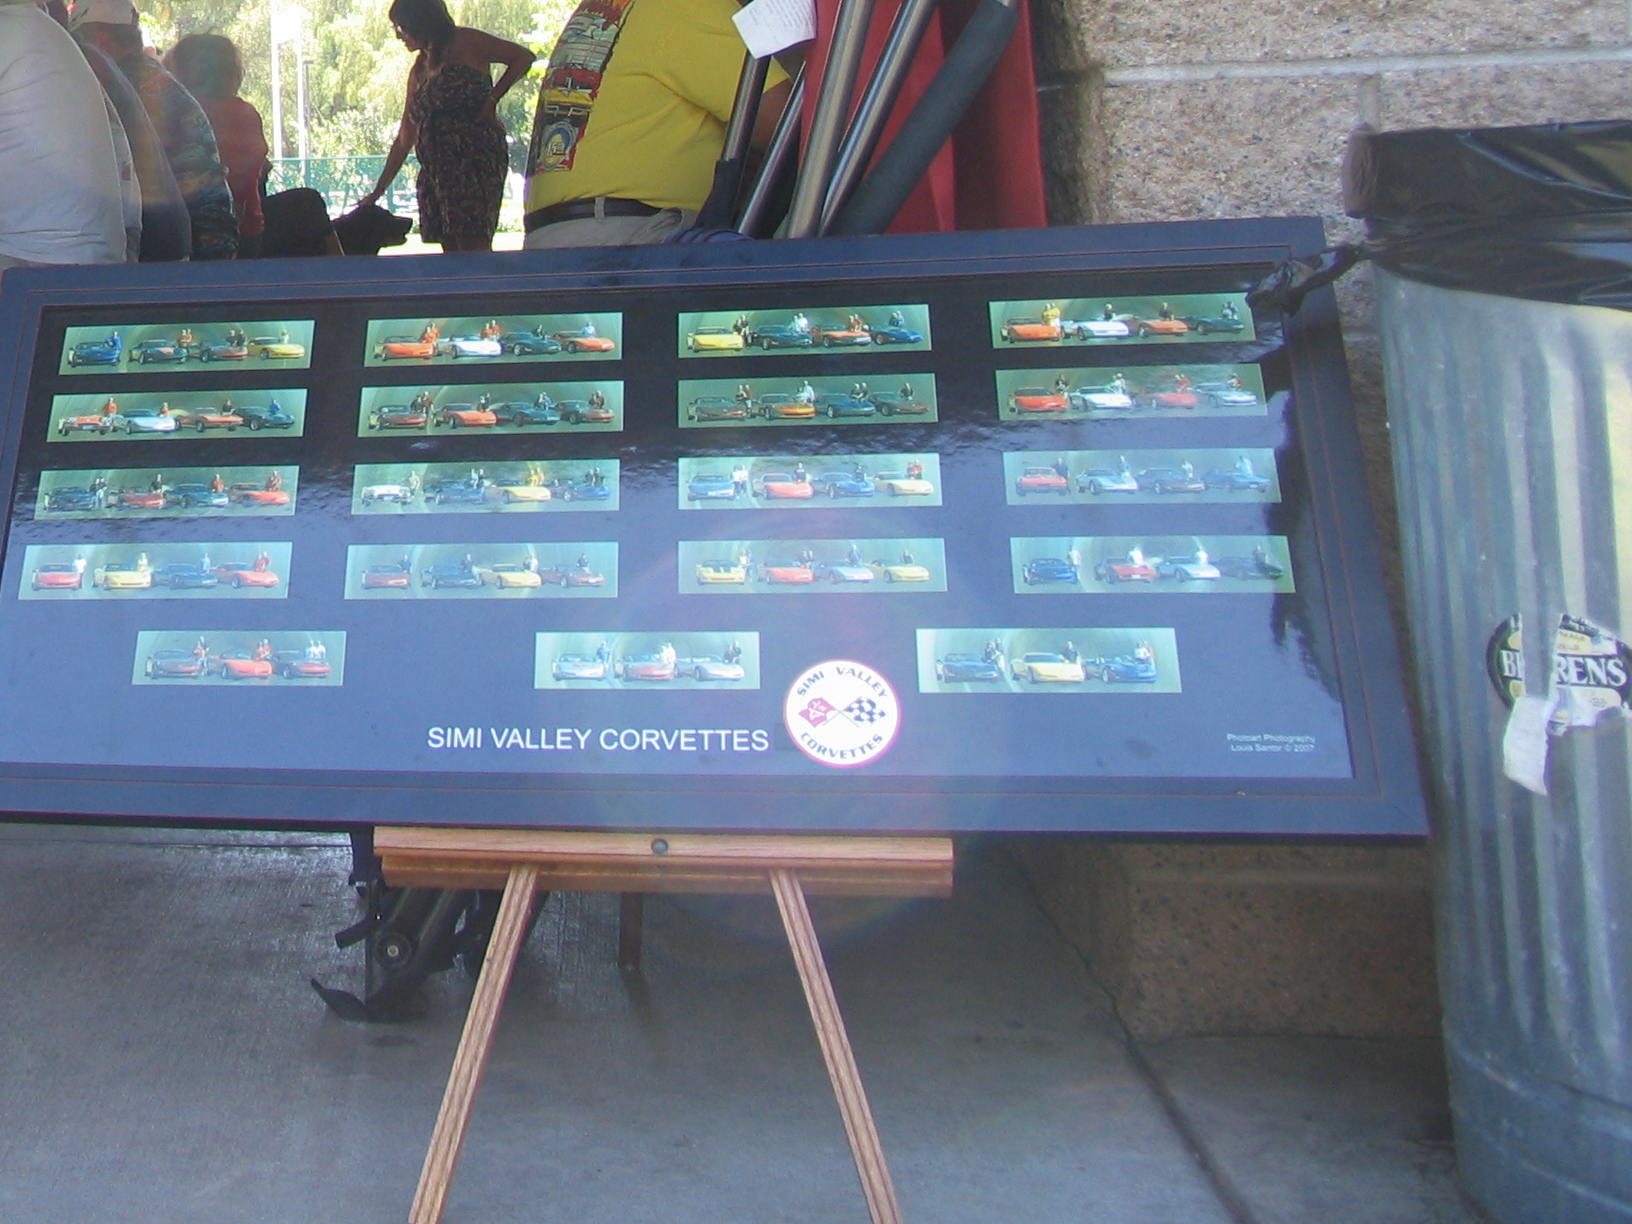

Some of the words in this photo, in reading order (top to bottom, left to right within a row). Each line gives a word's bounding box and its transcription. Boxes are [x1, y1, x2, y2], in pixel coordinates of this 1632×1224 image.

[797, 670, 825, 697] SIMI
[835, 666, 887, 698] VALLEY
[426, 726, 483, 749] SIMI
[490, 727, 593, 750] VALLEY
[599, 728, 770, 752] CORVETTES
[800, 732, 883, 759] CORVETTES
